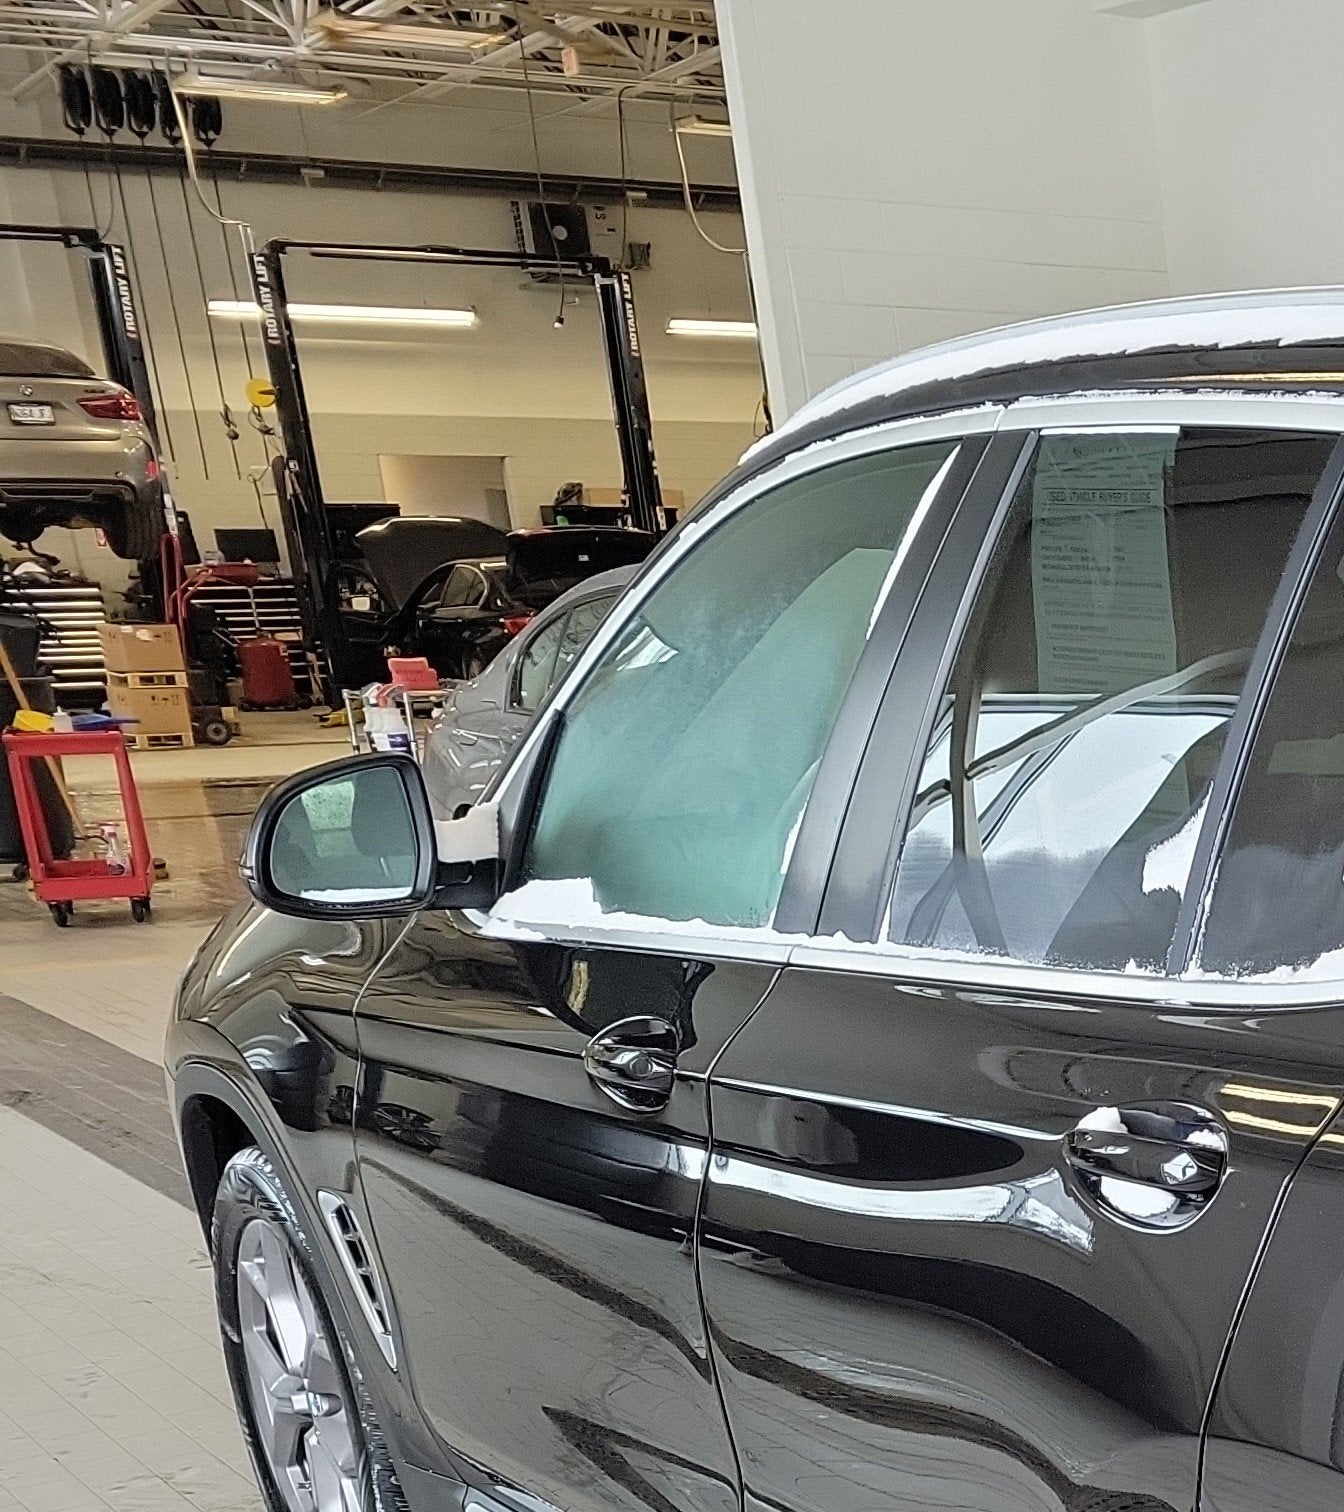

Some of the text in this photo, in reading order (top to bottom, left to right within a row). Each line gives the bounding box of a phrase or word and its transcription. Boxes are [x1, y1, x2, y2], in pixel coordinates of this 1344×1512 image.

[111, 245, 137, 331] ROTARY LIFT
[253, 254, 279, 337] ROTARY LIFT
[621, 273, 639, 351] ROTARY LIFT
